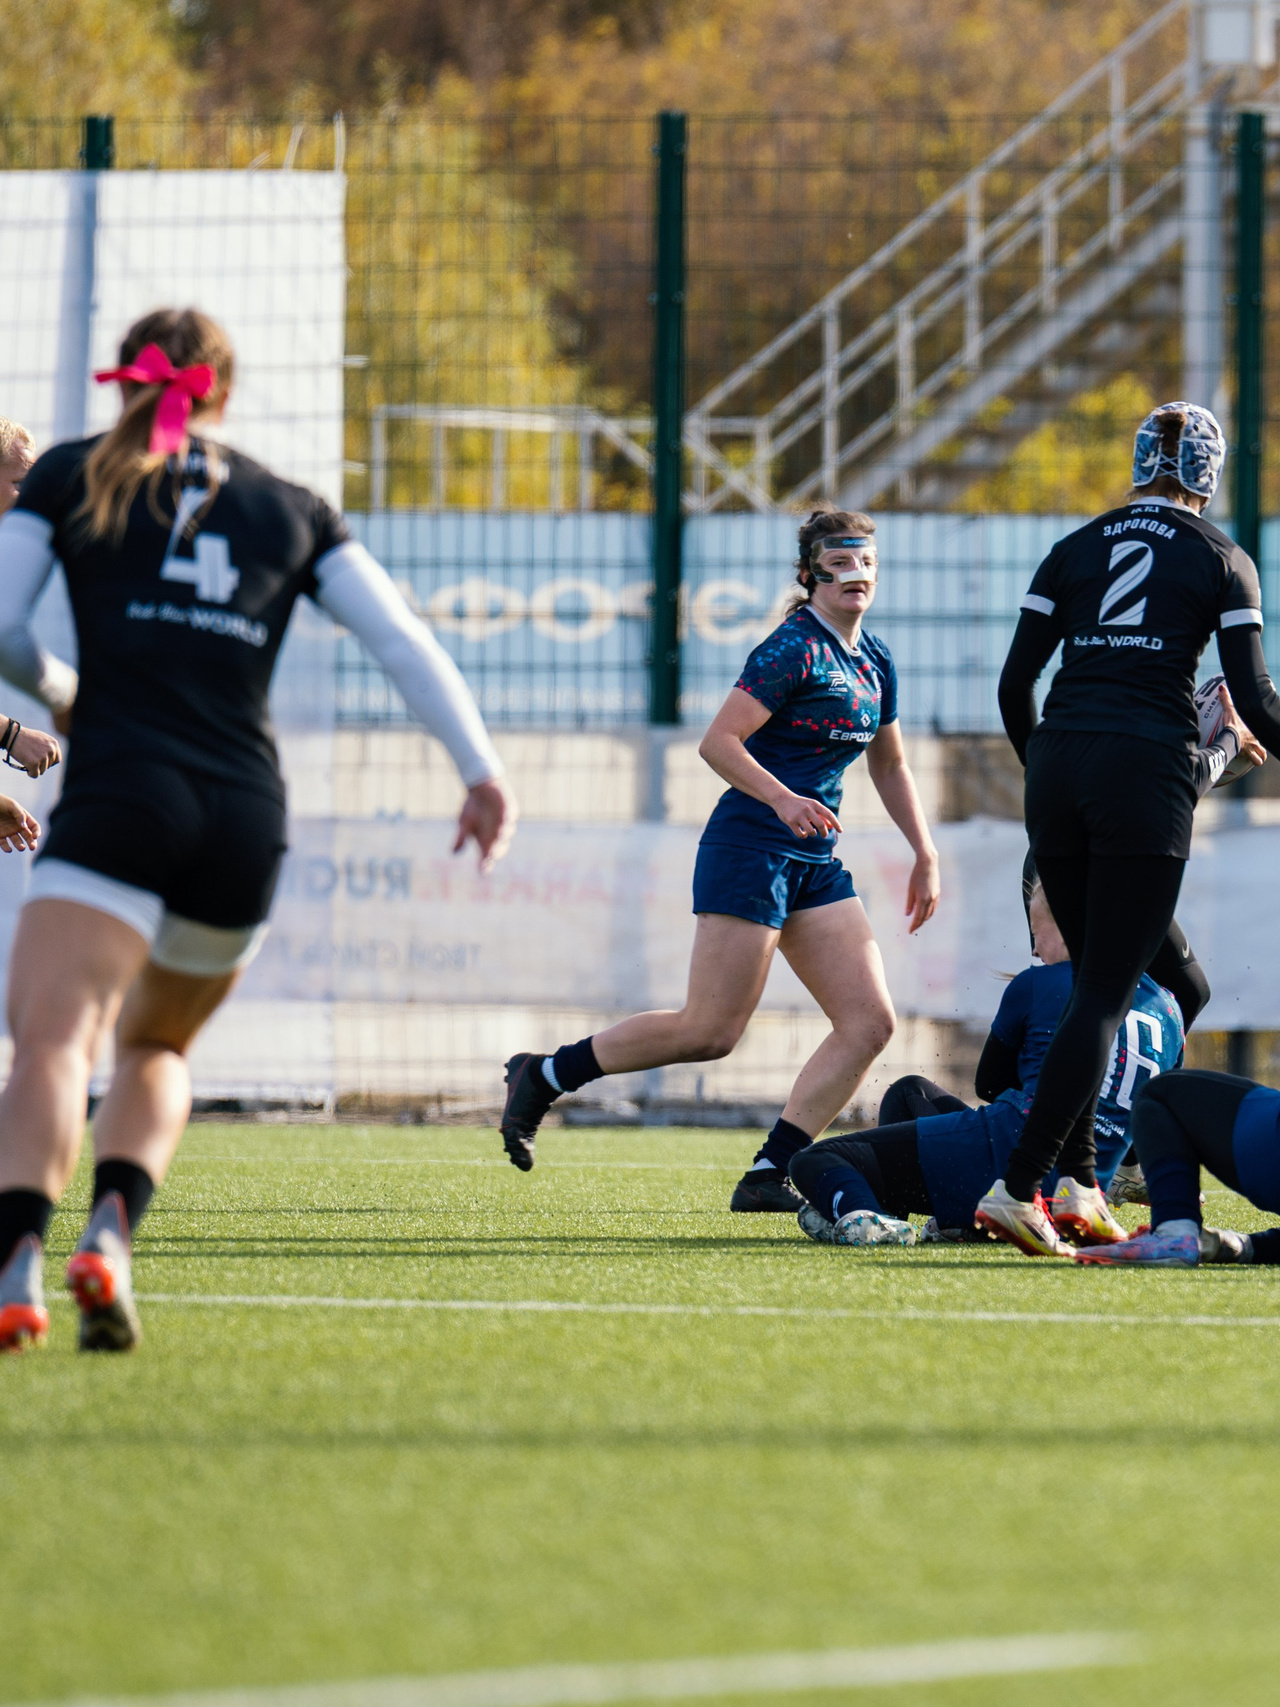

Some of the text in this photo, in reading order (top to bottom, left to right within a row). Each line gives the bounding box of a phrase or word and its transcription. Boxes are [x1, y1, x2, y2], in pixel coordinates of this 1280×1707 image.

[160, 486, 240, 604] 4
[1103, 517, 1177, 541] ЗДРОКОВА
[1098, 540, 1154, 626] 2
[1107, 635, 1163, 651] WORLD
